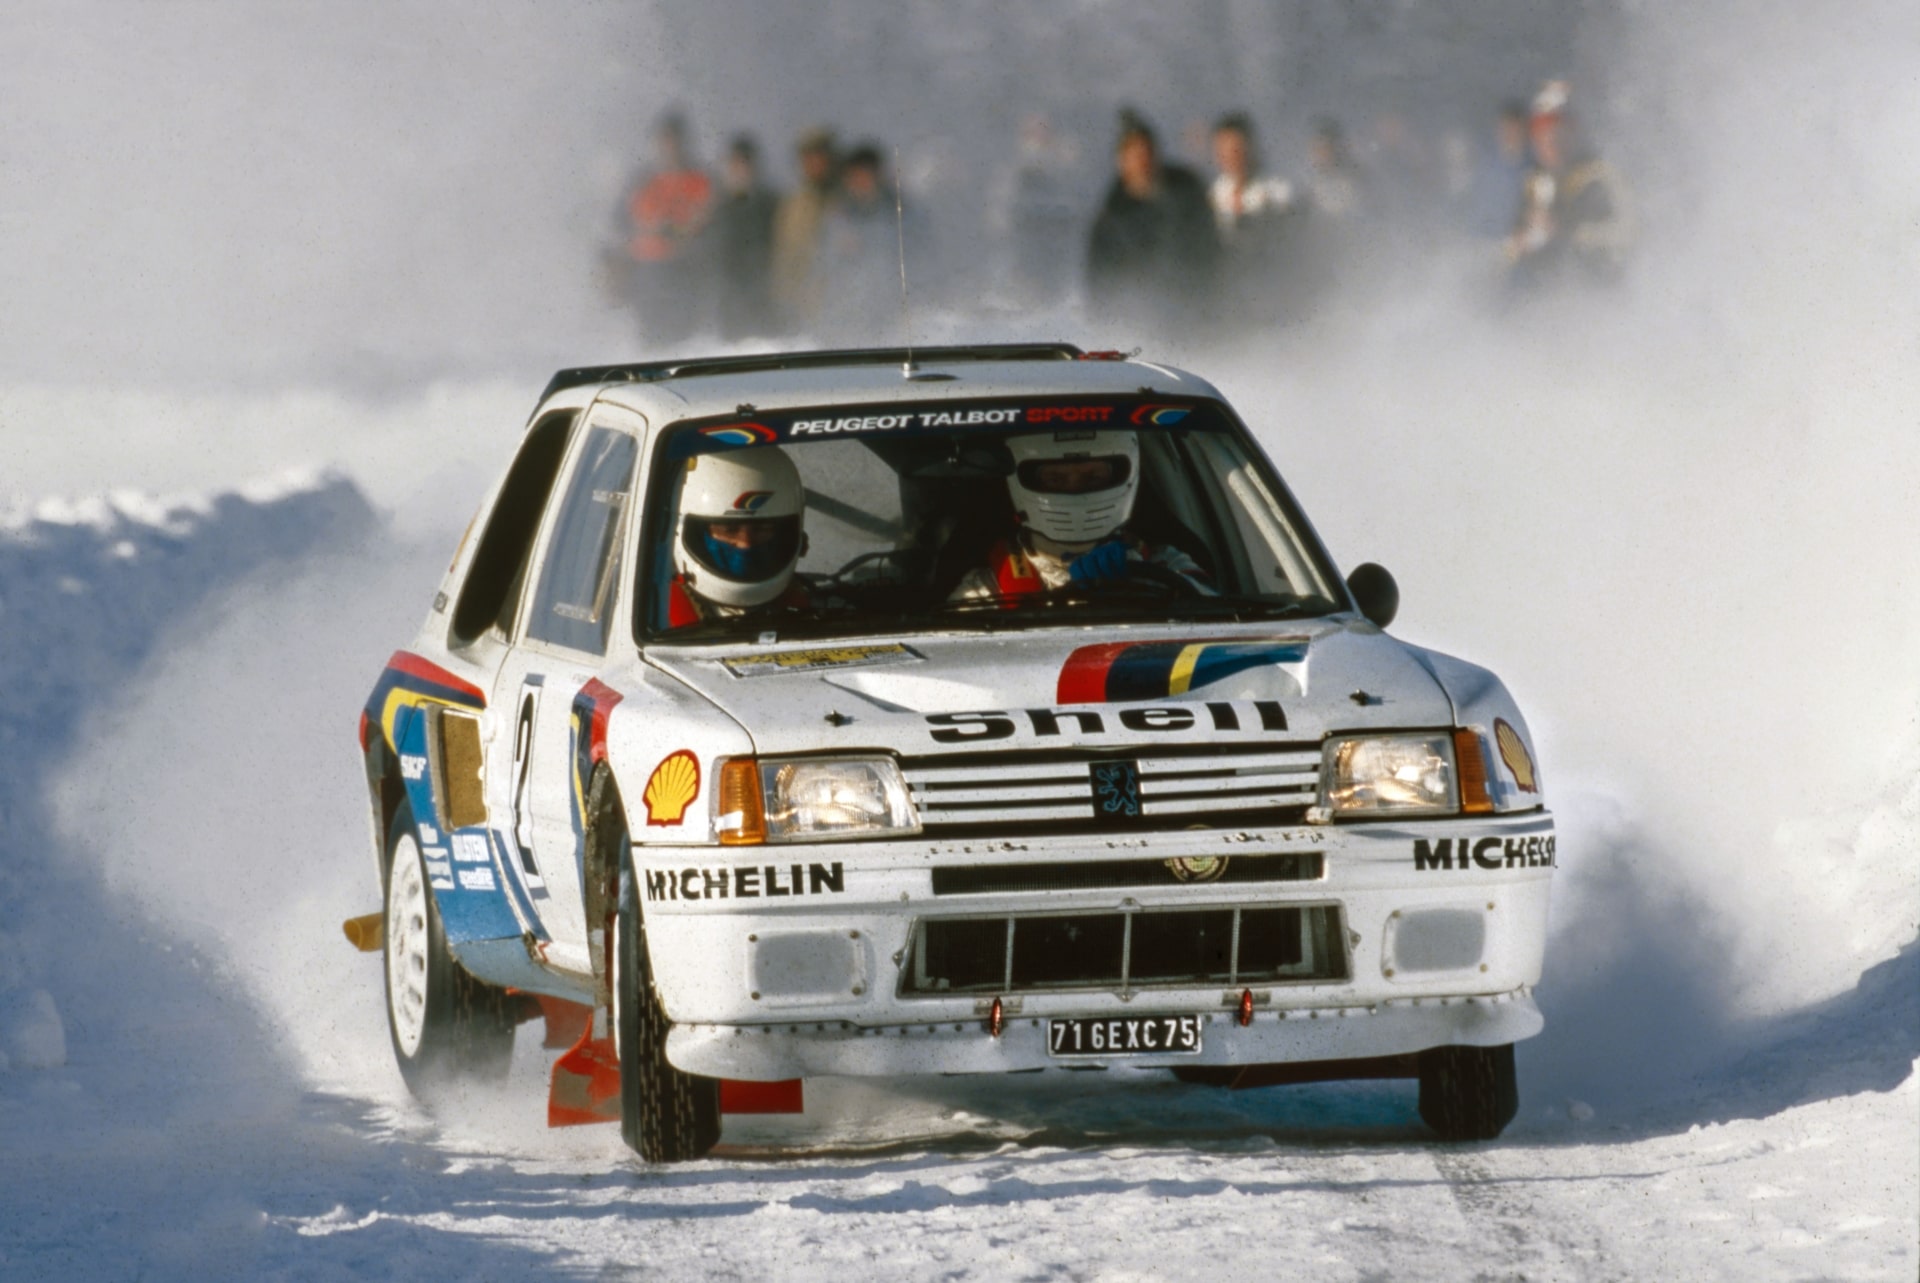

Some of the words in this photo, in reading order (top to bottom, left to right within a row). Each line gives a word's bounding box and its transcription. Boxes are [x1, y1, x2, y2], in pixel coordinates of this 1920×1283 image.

[790, 414, 914, 435] PEUGEOT
[919, 409, 1021, 427] TALBOT
[1025, 406, 1115, 423] SPORT
[925, 701, 1289, 743] Shell
[645, 861, 845, 900] MICHELIN
